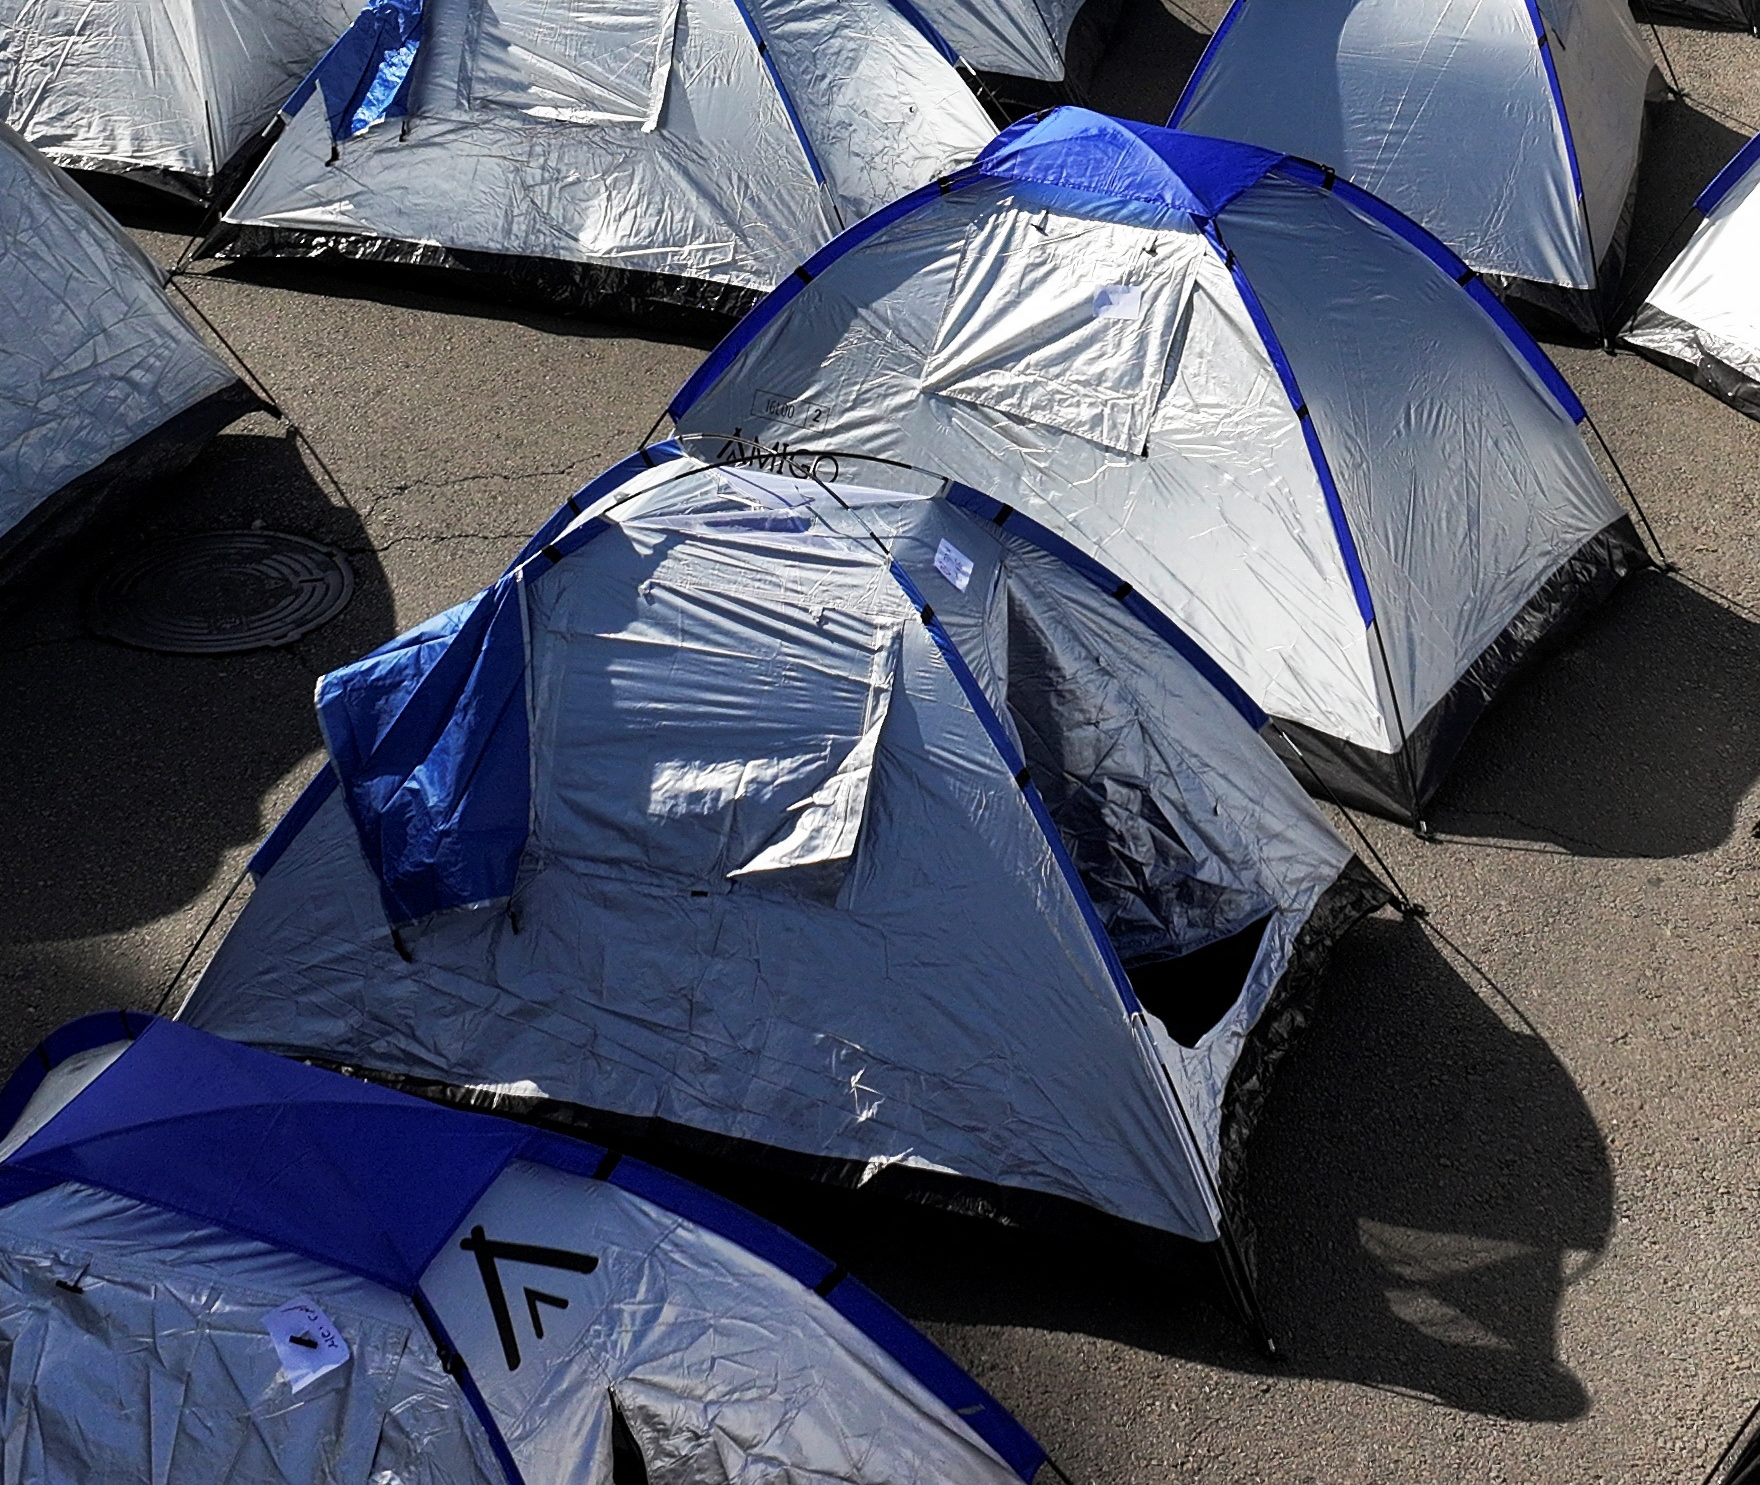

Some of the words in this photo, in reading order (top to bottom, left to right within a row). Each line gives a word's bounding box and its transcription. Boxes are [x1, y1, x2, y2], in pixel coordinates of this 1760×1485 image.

[765, 398, 795, 419] IGLOO
[811, 409, 823, 423] 2
[716, 426, 839, 483] AMIGO
